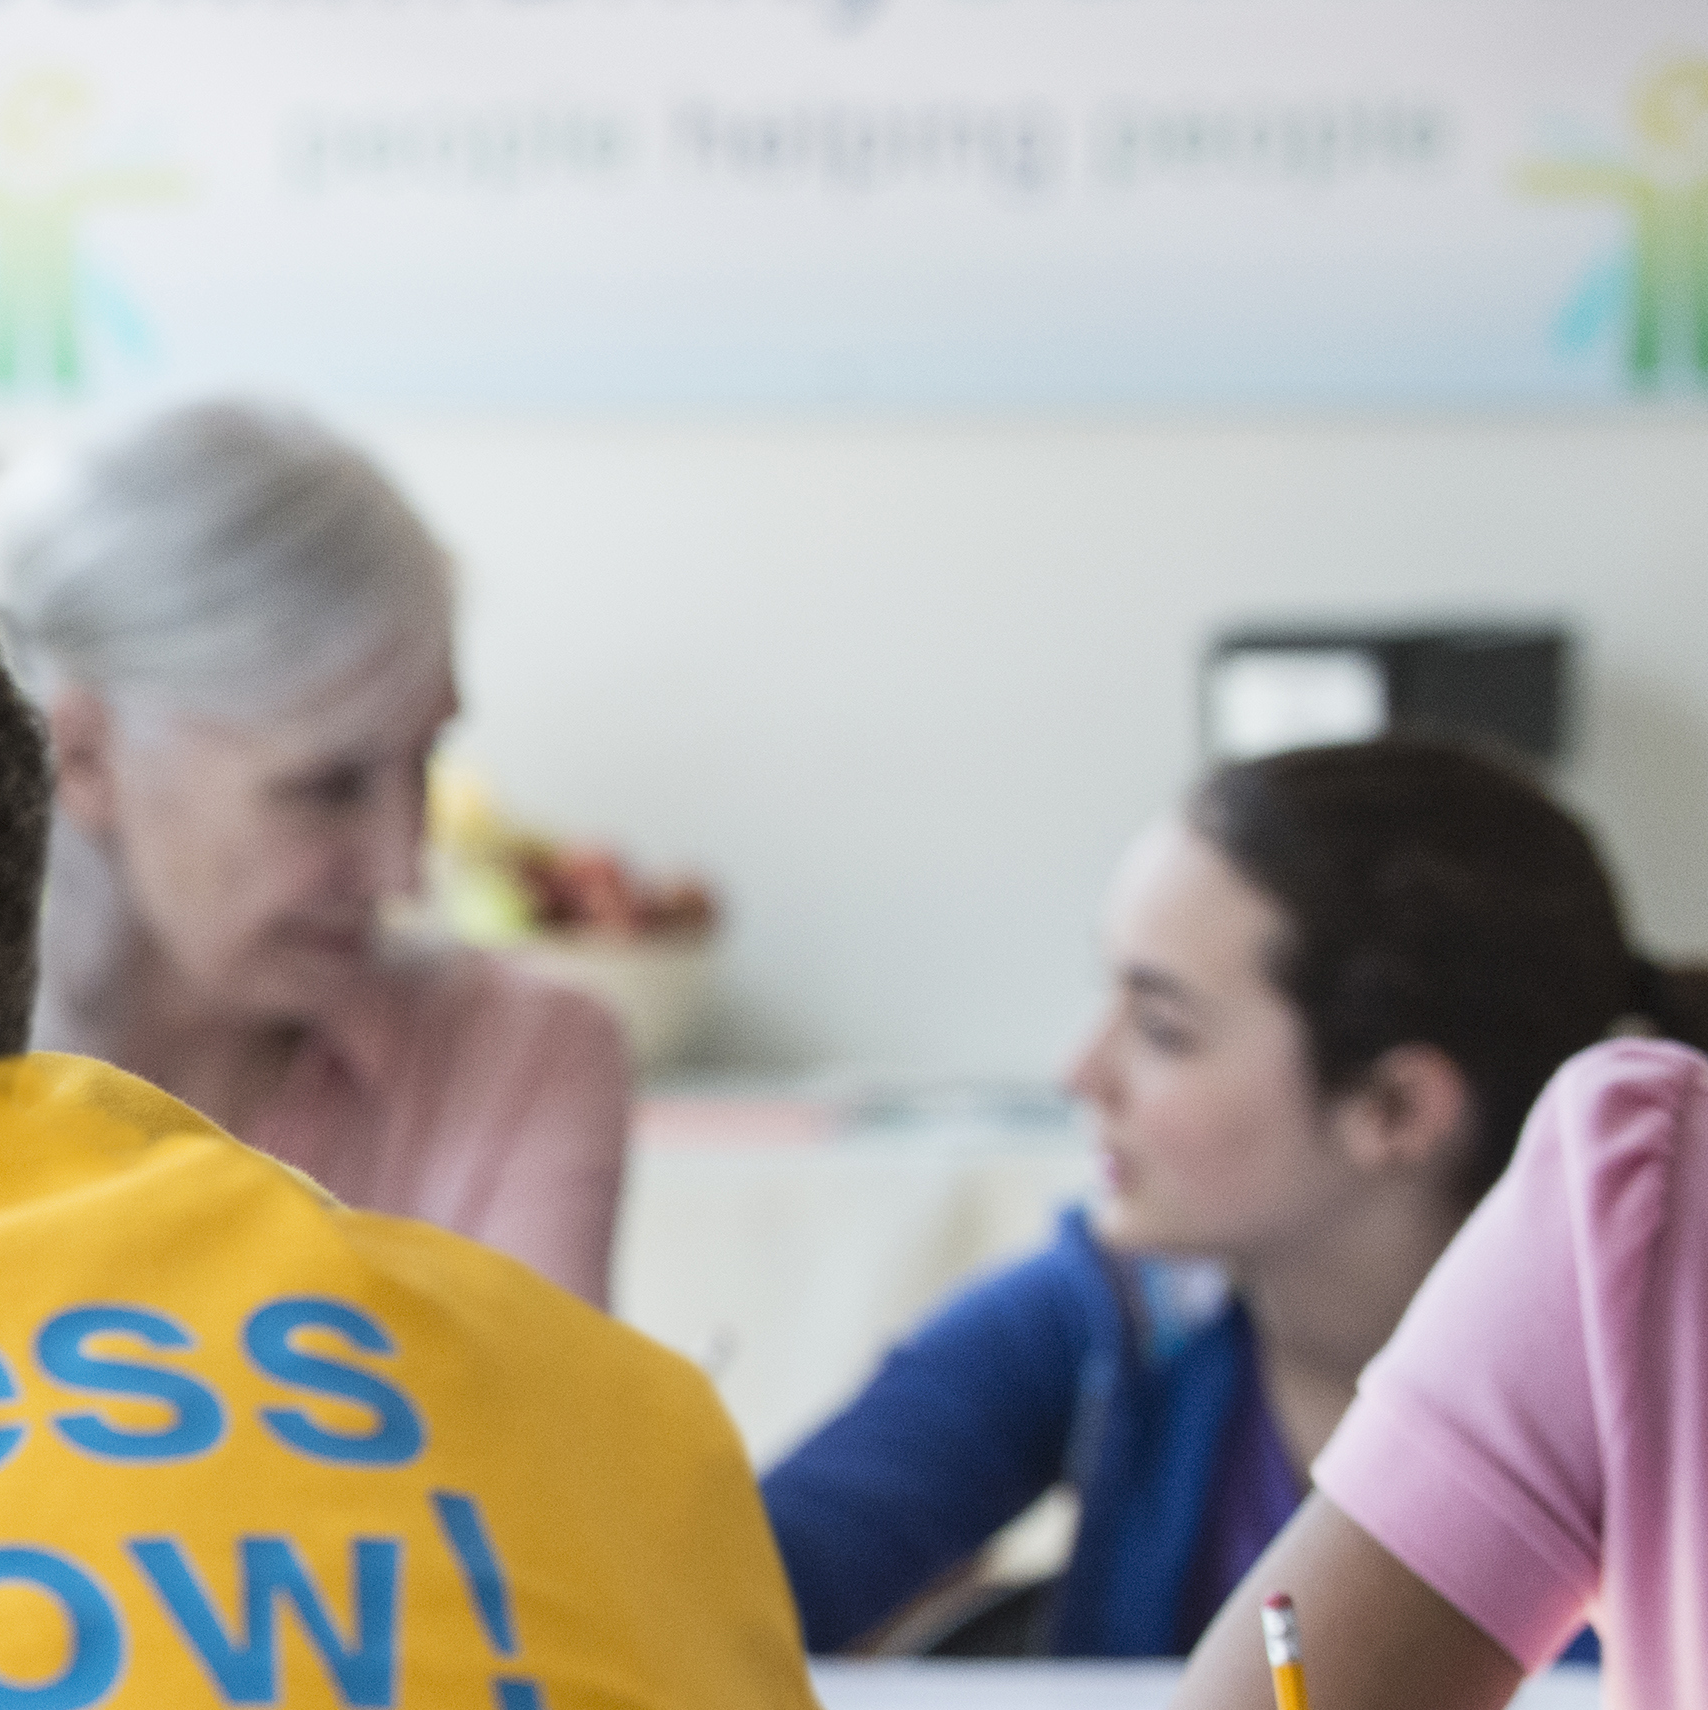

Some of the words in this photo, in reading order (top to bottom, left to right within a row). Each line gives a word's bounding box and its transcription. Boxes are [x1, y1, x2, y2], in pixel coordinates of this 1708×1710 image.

[285, 102, 627, 195] people
[669, 95, 1049, 200] helping
[1090, 98, 1449, 188] people
